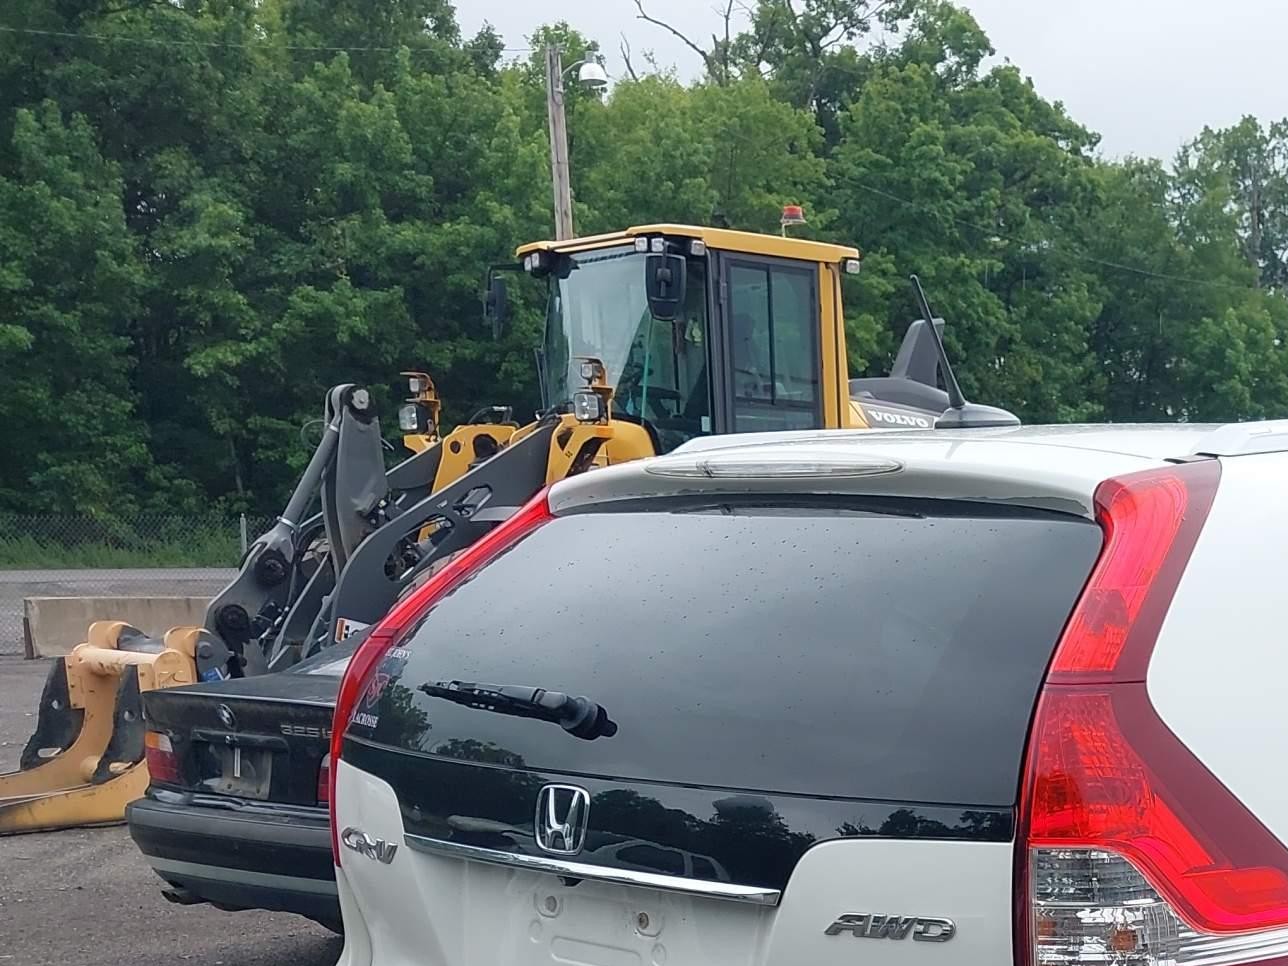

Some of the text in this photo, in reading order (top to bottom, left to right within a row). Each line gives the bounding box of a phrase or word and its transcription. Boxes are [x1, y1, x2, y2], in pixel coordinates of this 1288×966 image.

[867, 409, 929, 428] VOLVO
[341, 826, 398, 865] CR-V
[823, 912, 957, 942] AWD
